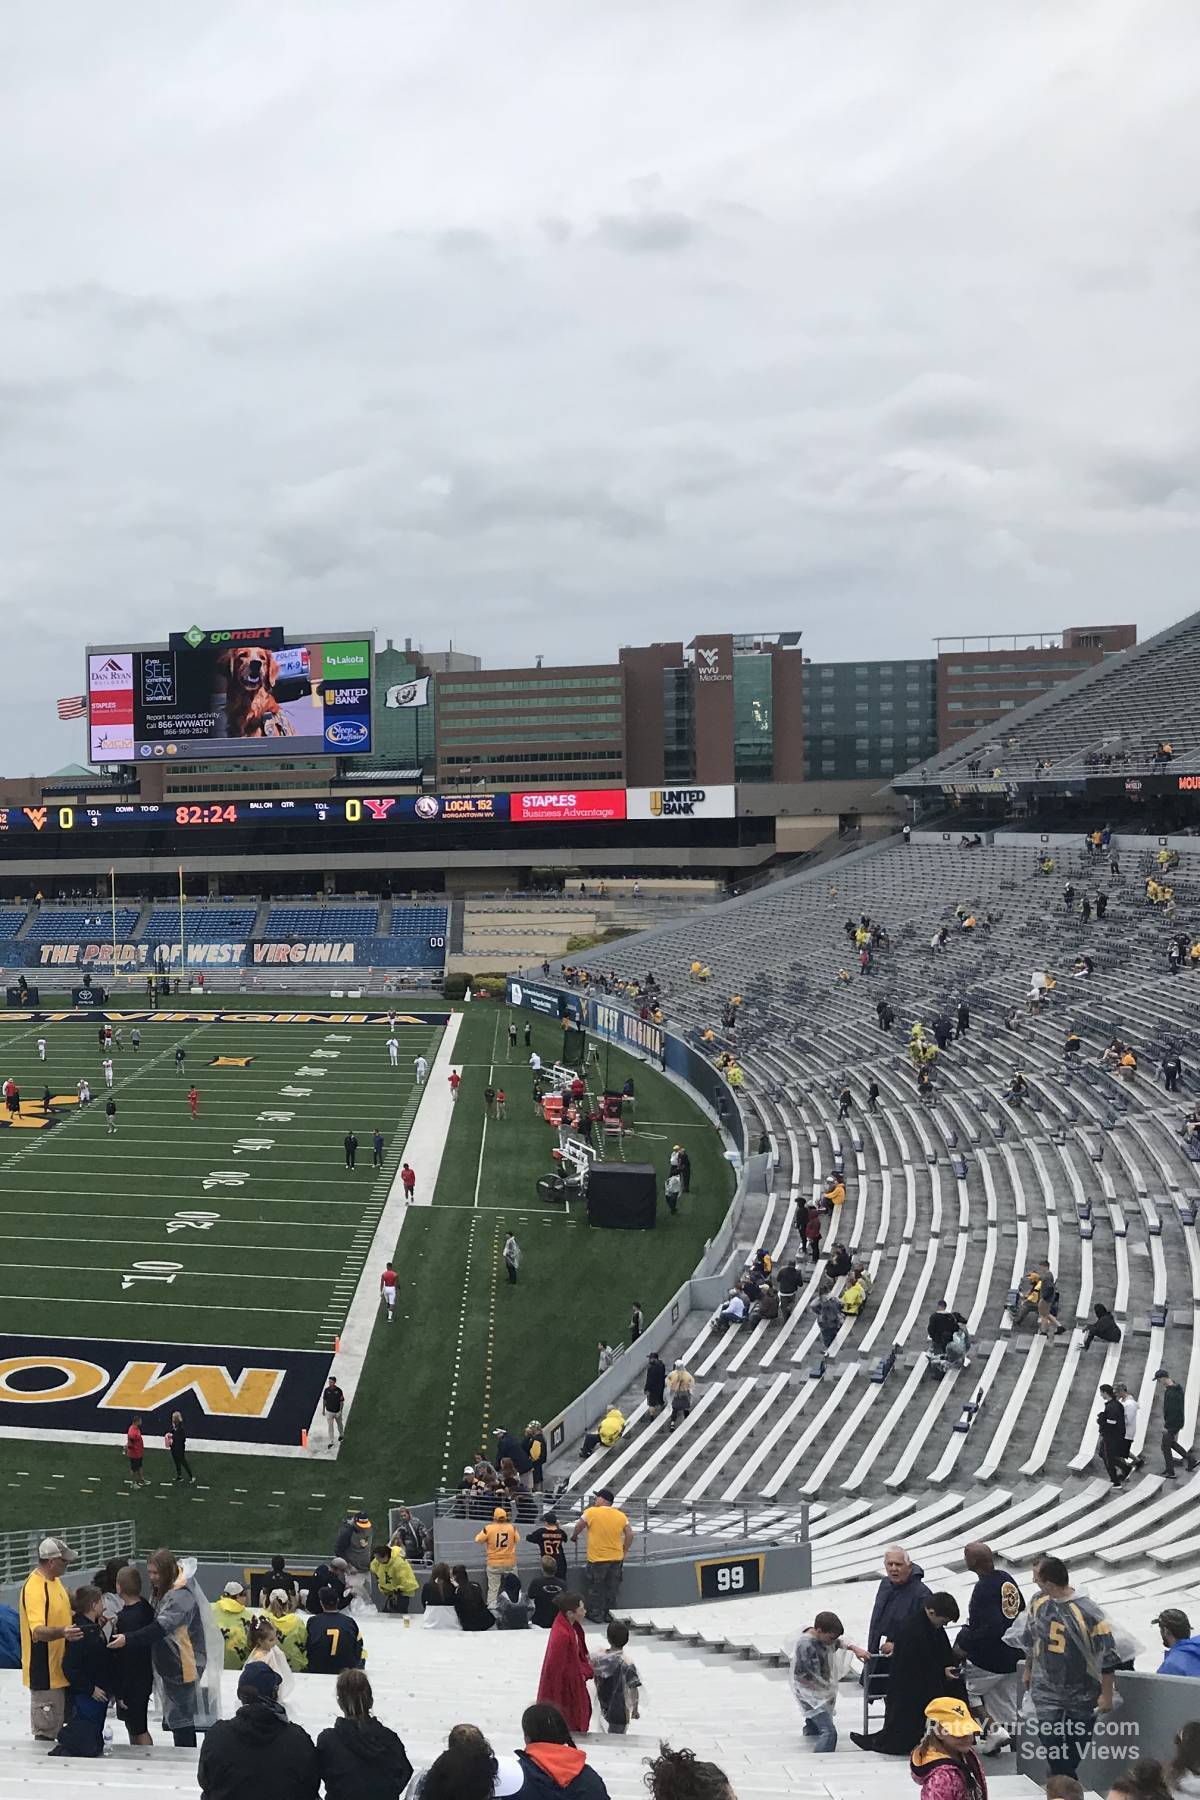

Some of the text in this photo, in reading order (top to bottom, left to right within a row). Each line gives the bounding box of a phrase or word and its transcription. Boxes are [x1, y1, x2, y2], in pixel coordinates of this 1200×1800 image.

[210, 628, 272, 644] gomart
[287, 662, 301, 670] K-9
[337, 656, 364, 664] Lakota
[91, 671, 132, 681] DAN RYAN
[145, 663, 171, 679] SEE
[145, 682, 173, 697] SAY
[335, 688, 368, 697] UNITED
[335, 696, 360, 705] BANK
[158, 720, 215, 728] 866-WVWATCH
[522, 795, 576, 807] STAPLES
[663, 790, 706, 803] UNITED
[345, 799, 361, 821] 0
[363, 799, 396, 819] Y
[445, 800, 492, 811] LOCAL 152
[522, 808, 614, 818] Business Advantage
[663, 803, 694, 815] BANK
[59, 807, 73, 828] 0
[91, 818, 98, 826] 3
[175, 805, 238, 824] 82:24
[318, 810, 326, 821] 3
[429, 937, 444, 948] 00
[40, 943, 355, 964] THE PRIDE OF WEST VIRGINIA
[102, 1011, 428, 1024] VIRGINIA
[596, 1004, 661, 1055] WEST VIRGINIA
[202, 1171, 250, 1186] 30
[165, 1211, 221, 1229] 20
[122, 1261, 184, 1283] 10
[495, 1532, 509, 1548] 12
[543, 1540, 561, 1555] 67
[717, 1566, 744, 1591] 99
[326, 1628, 341, 1656] 7
[1047, 1621, 1066, 1654] 5
